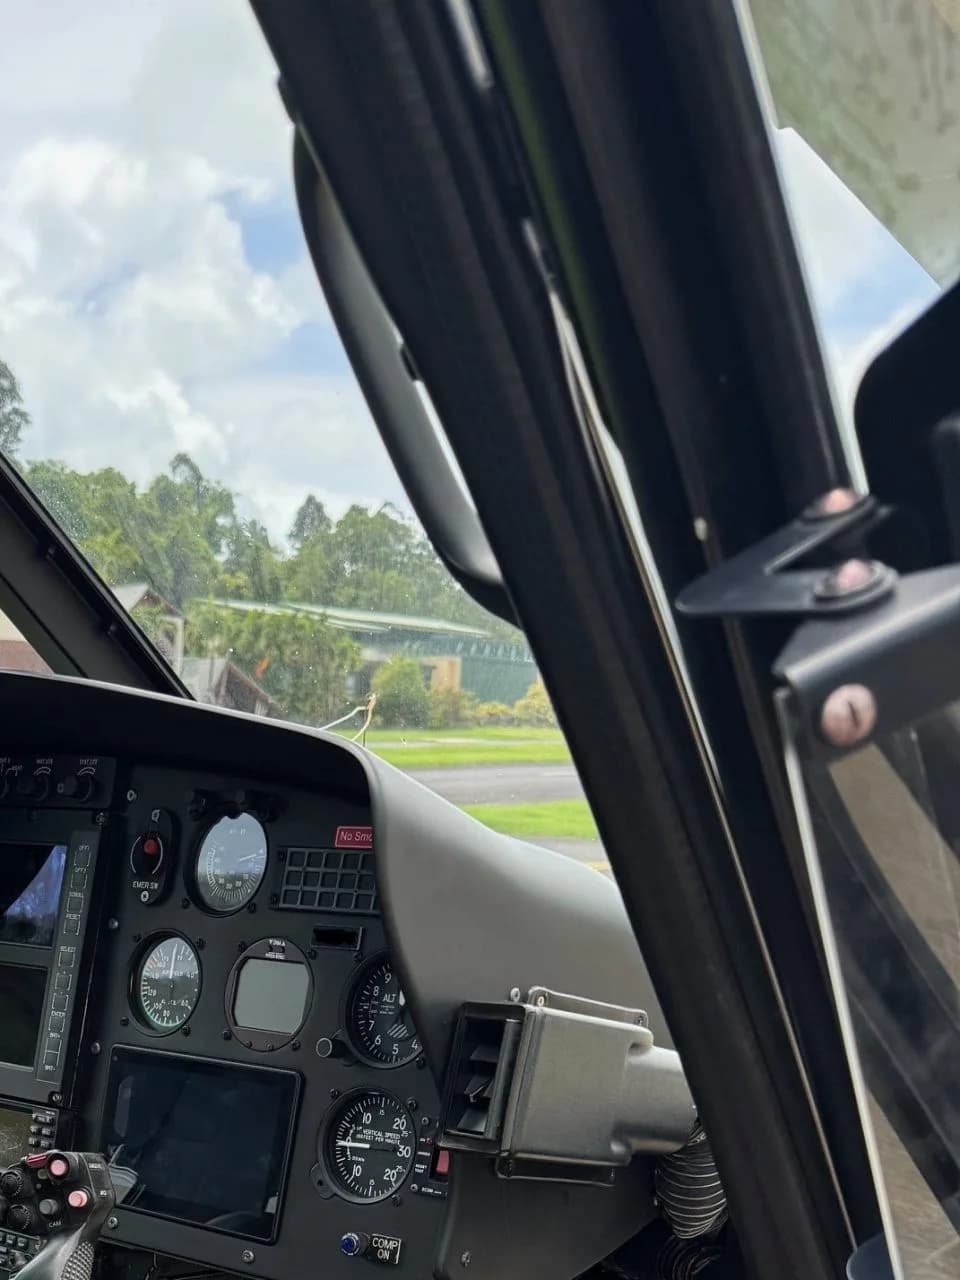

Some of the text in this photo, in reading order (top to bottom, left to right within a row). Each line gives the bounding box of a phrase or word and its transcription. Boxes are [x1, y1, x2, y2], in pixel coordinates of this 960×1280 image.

[341, 831, 373, 842] No Smo
[384, 972, 392, 984] 9
[372, 985, 380, 997] 8
[369, 1020, 376, 1031] 7
[374, 1034, 382, 1045] 6
[411, 1038, 418, 1050] 4
[391, 1043, 400, 1055] 5
[362, 1112, 372, 1125] 10
[392, 1117, 407, 1130] 20
[397, 1145, 411, 1158] 30
[352, 1163, 362, 1177] 10
[383, 1168, 397, 1181] 20
[372, 1237, 398, 1250] COMP
[377, 1249, 390, 1260] ON
